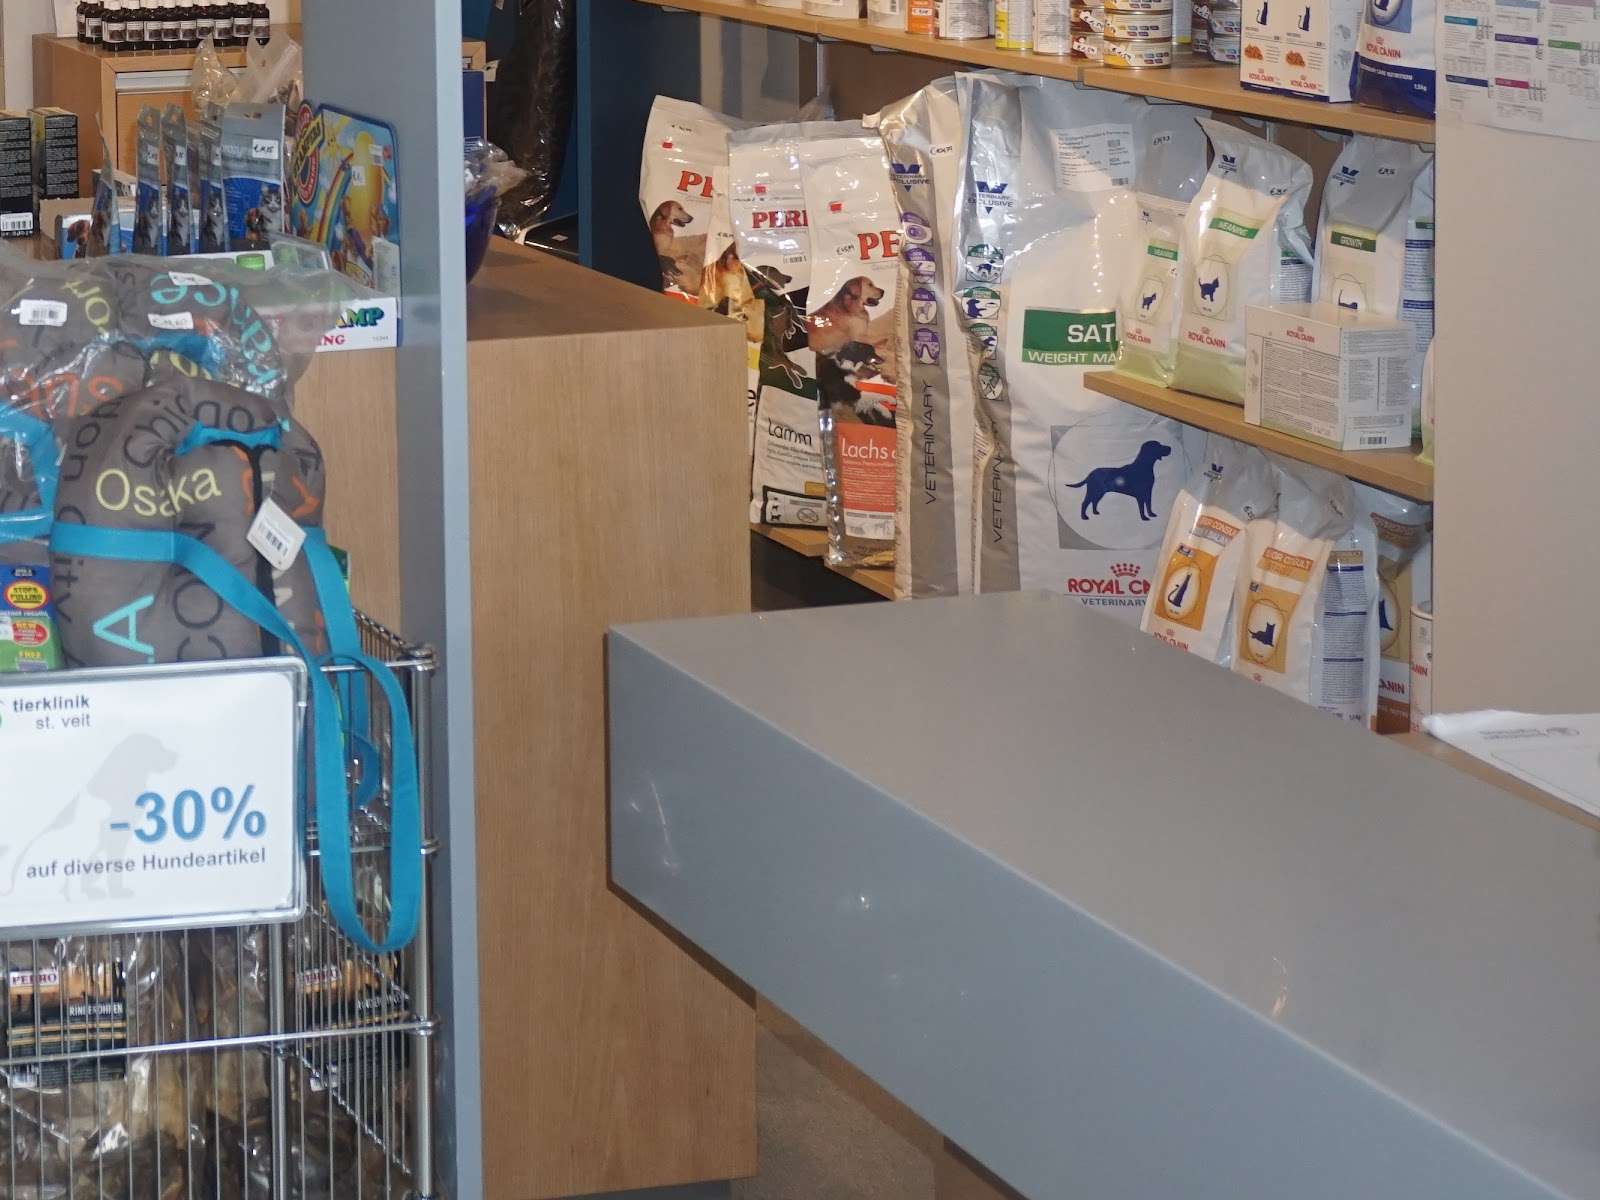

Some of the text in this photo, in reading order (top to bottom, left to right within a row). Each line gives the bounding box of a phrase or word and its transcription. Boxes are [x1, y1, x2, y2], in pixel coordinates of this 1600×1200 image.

[1028, 350, 1089, 364] WEIGHT
[768, 417, 813, 447] Lamm
[923, 380, 939, 506] VETERINARY
[842, 438, 888, 460] Lachs
[1067, 578, 1125, 595] ROYAL
[13, 695, 91, 713] tierklinik
[35, 715, 91, 730] st. veit
[110, 783, 267, 844] -30%
[26, 847, 267, 879] auf diverse Hundeartikel
